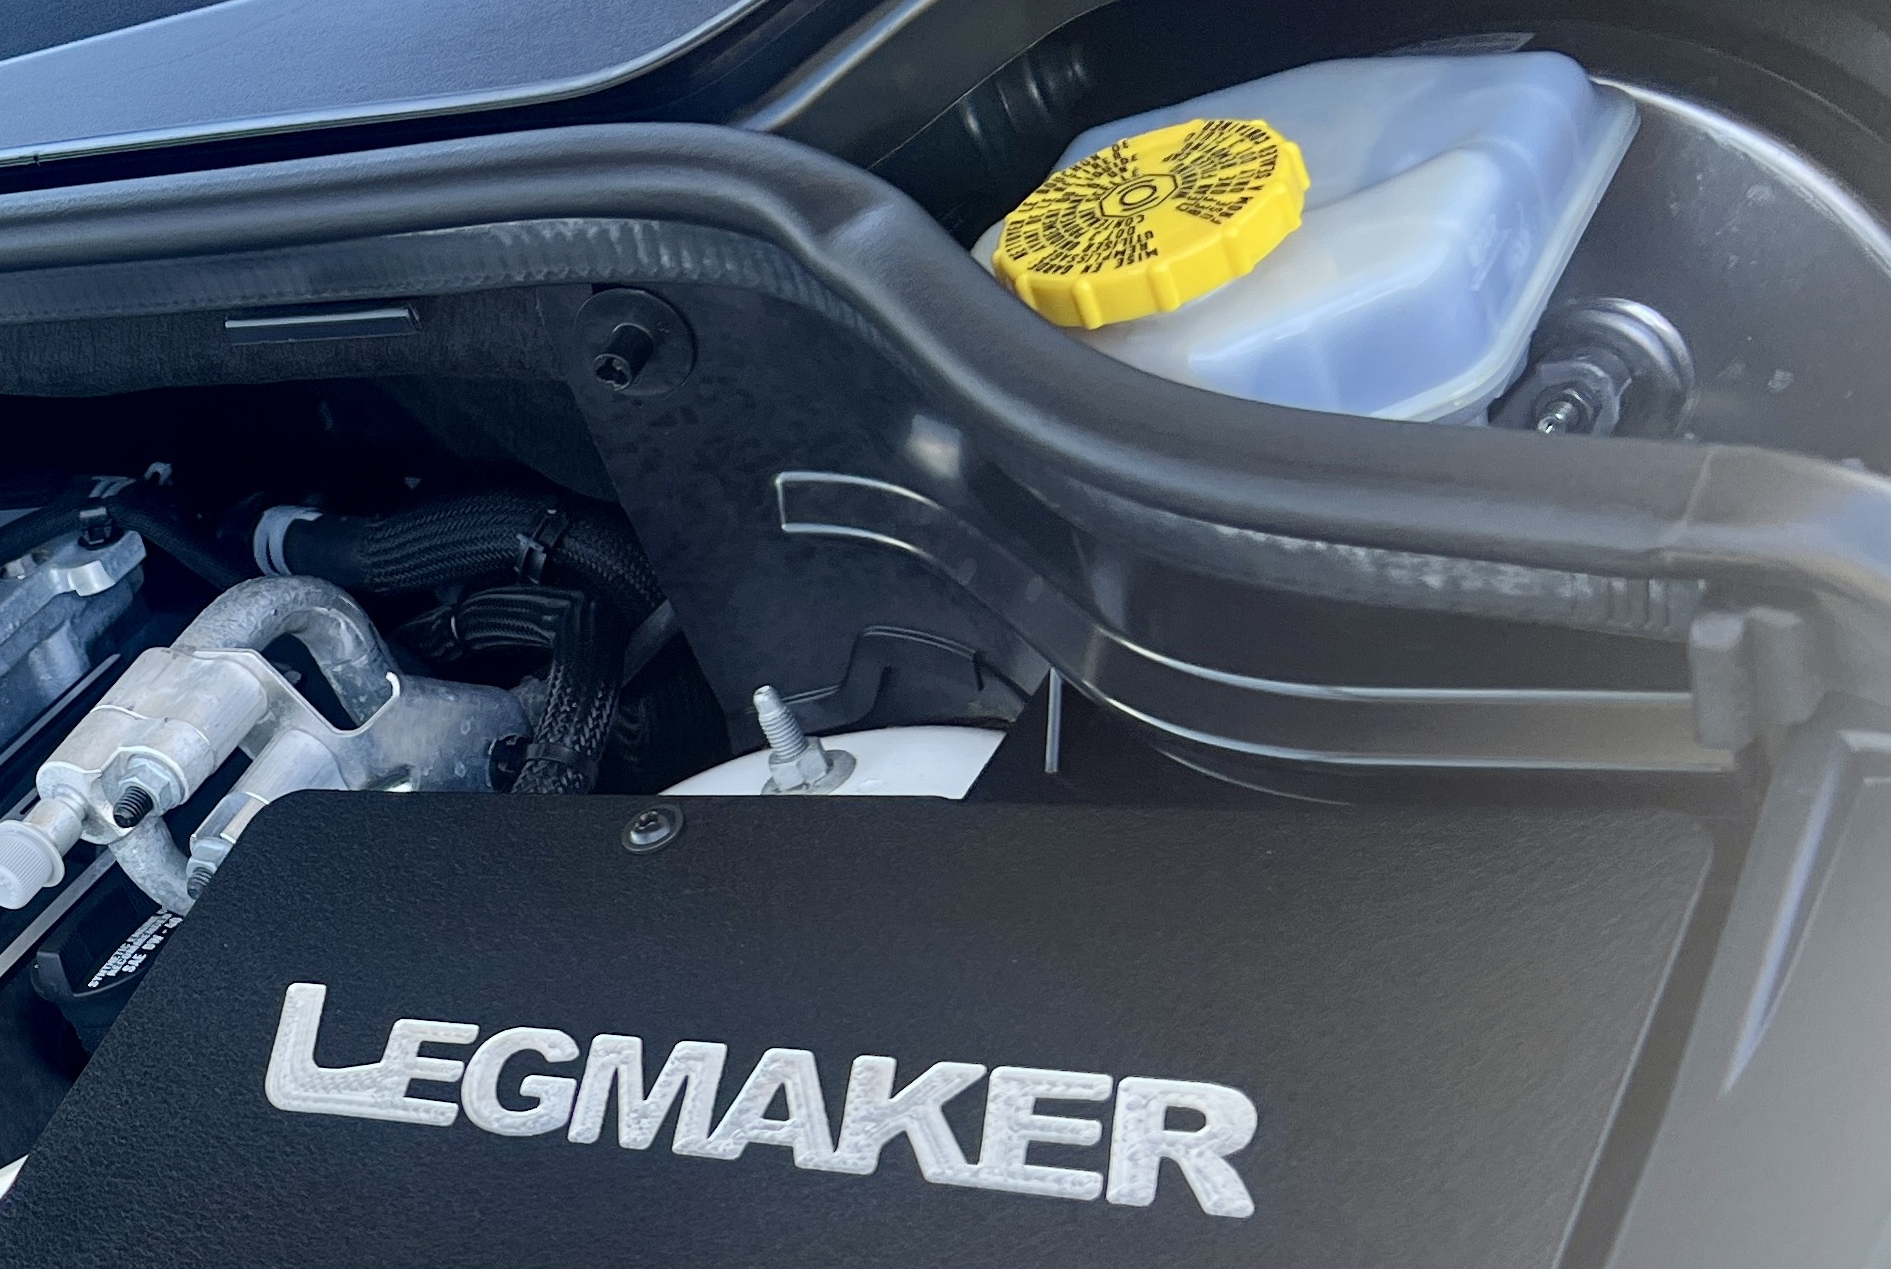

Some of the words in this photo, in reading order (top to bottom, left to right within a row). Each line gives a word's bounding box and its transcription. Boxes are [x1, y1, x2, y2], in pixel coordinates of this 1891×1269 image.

[1181, 131, 1233, 144] FLUID
[1200, 120, 1271, 145] CONTAINER
[1162, 152, 1192, 163] CAP
[1179, 141, 1237, 170] REMOVING
[1234, 145, 1257, 165] DOT
[1253, 143, 1278, 180] SEALED
[1034, 153, 1101, 194] BOUCHON
[1051, 151, 1122, 192] RETIRER
[1074, 152, 1137, 187] LIQUIDE
[1226, 166, 1256, 193] ONLY
[1173, 181, 1214, 212] CLEAN
[1185, 173, 1236, 216] BEFORE
[1058, 193, 1090, 239] PROVENANT
[1197, 200, 1232, 220] USE
[1207, 195, 1255, 225] FROM
[1004, 218, 1029, 261] NETTOYER
[1022, 227, 1046, 253] AVANT
[1078, 229, 1154, 252] UTILISER
[1101, 224, 1136, 241] DOT
[1039, 241, 1148, 264] REMPLISSAGE
[1114, 247, 1158, 268] MISE
[87, 943, 131, 988] SYNTHETIC
[121, 953, 147, 973] SAE
[264, 982, 1258, 1218] LEGMAKER
